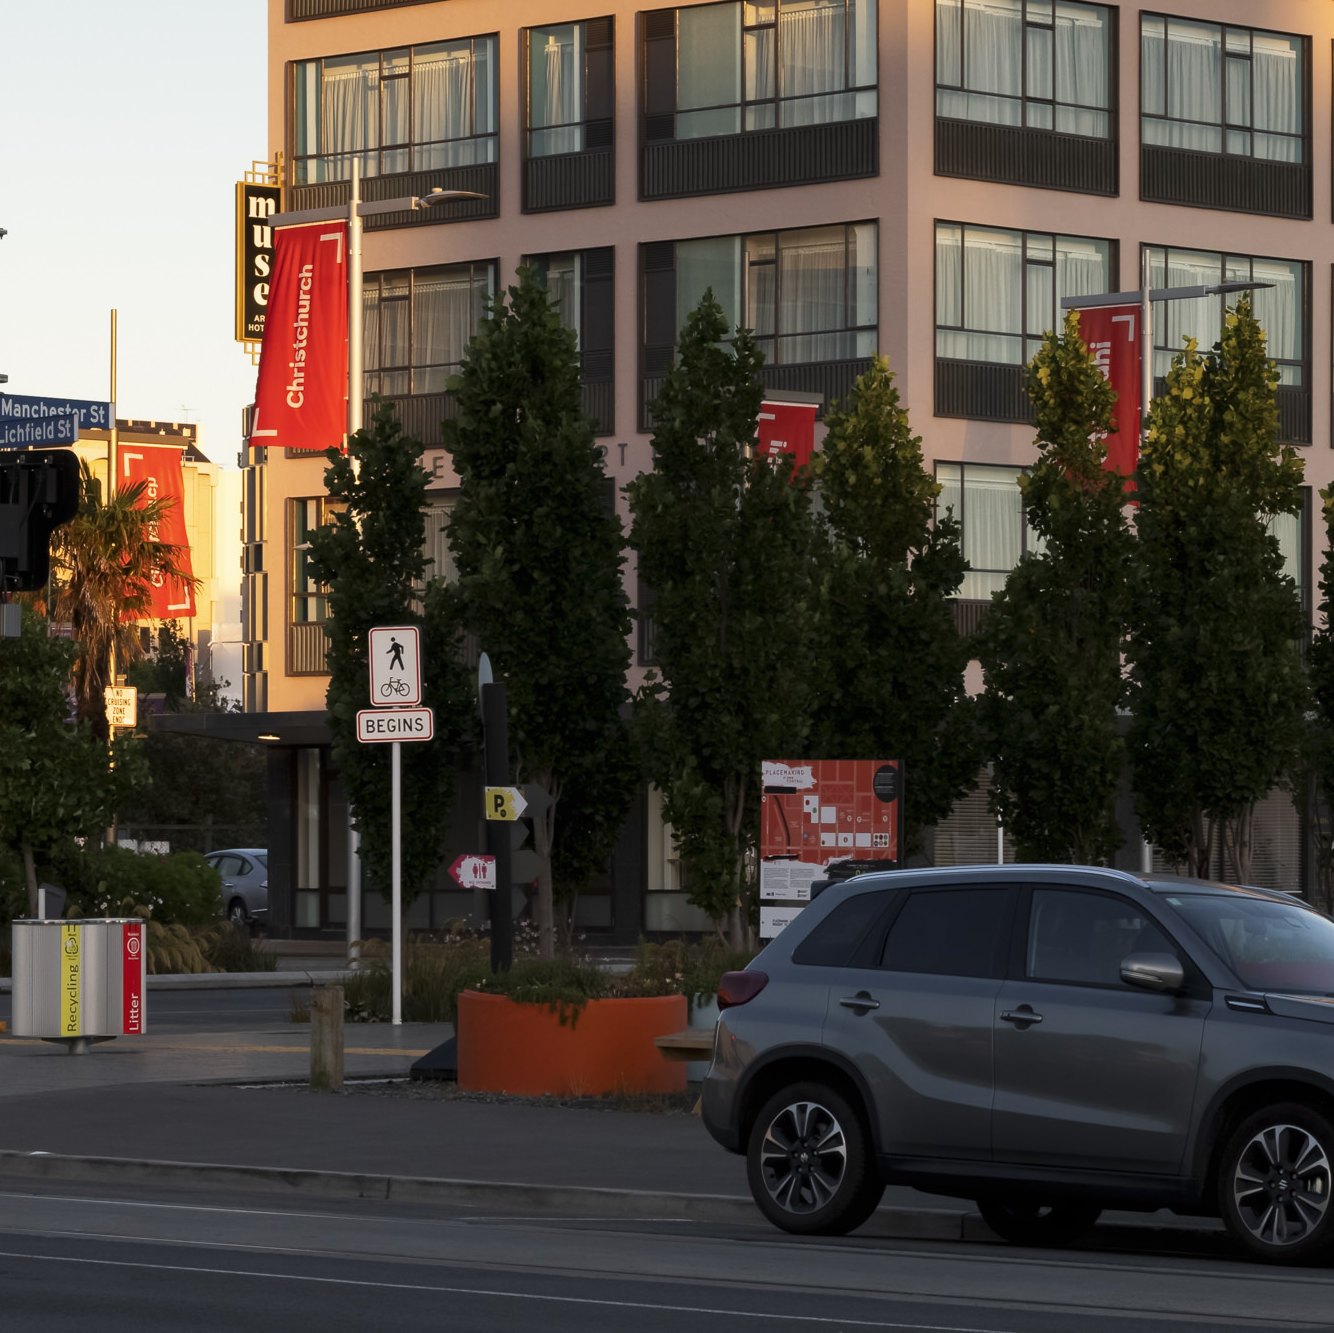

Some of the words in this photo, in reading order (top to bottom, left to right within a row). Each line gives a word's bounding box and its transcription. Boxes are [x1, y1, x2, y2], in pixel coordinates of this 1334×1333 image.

[286, 264, 314, 409] Christchurch
[90, 405, 105, 424] St
[57, 419, 71, 439] St
[112, 707, 126, 715] ZONE
[366, 717, 424, 733] BEGINS
[493, 794, 504, 813] P
[67, 964, 80, 1032] Recycling
[129, 992, 139, 1031] Litter
